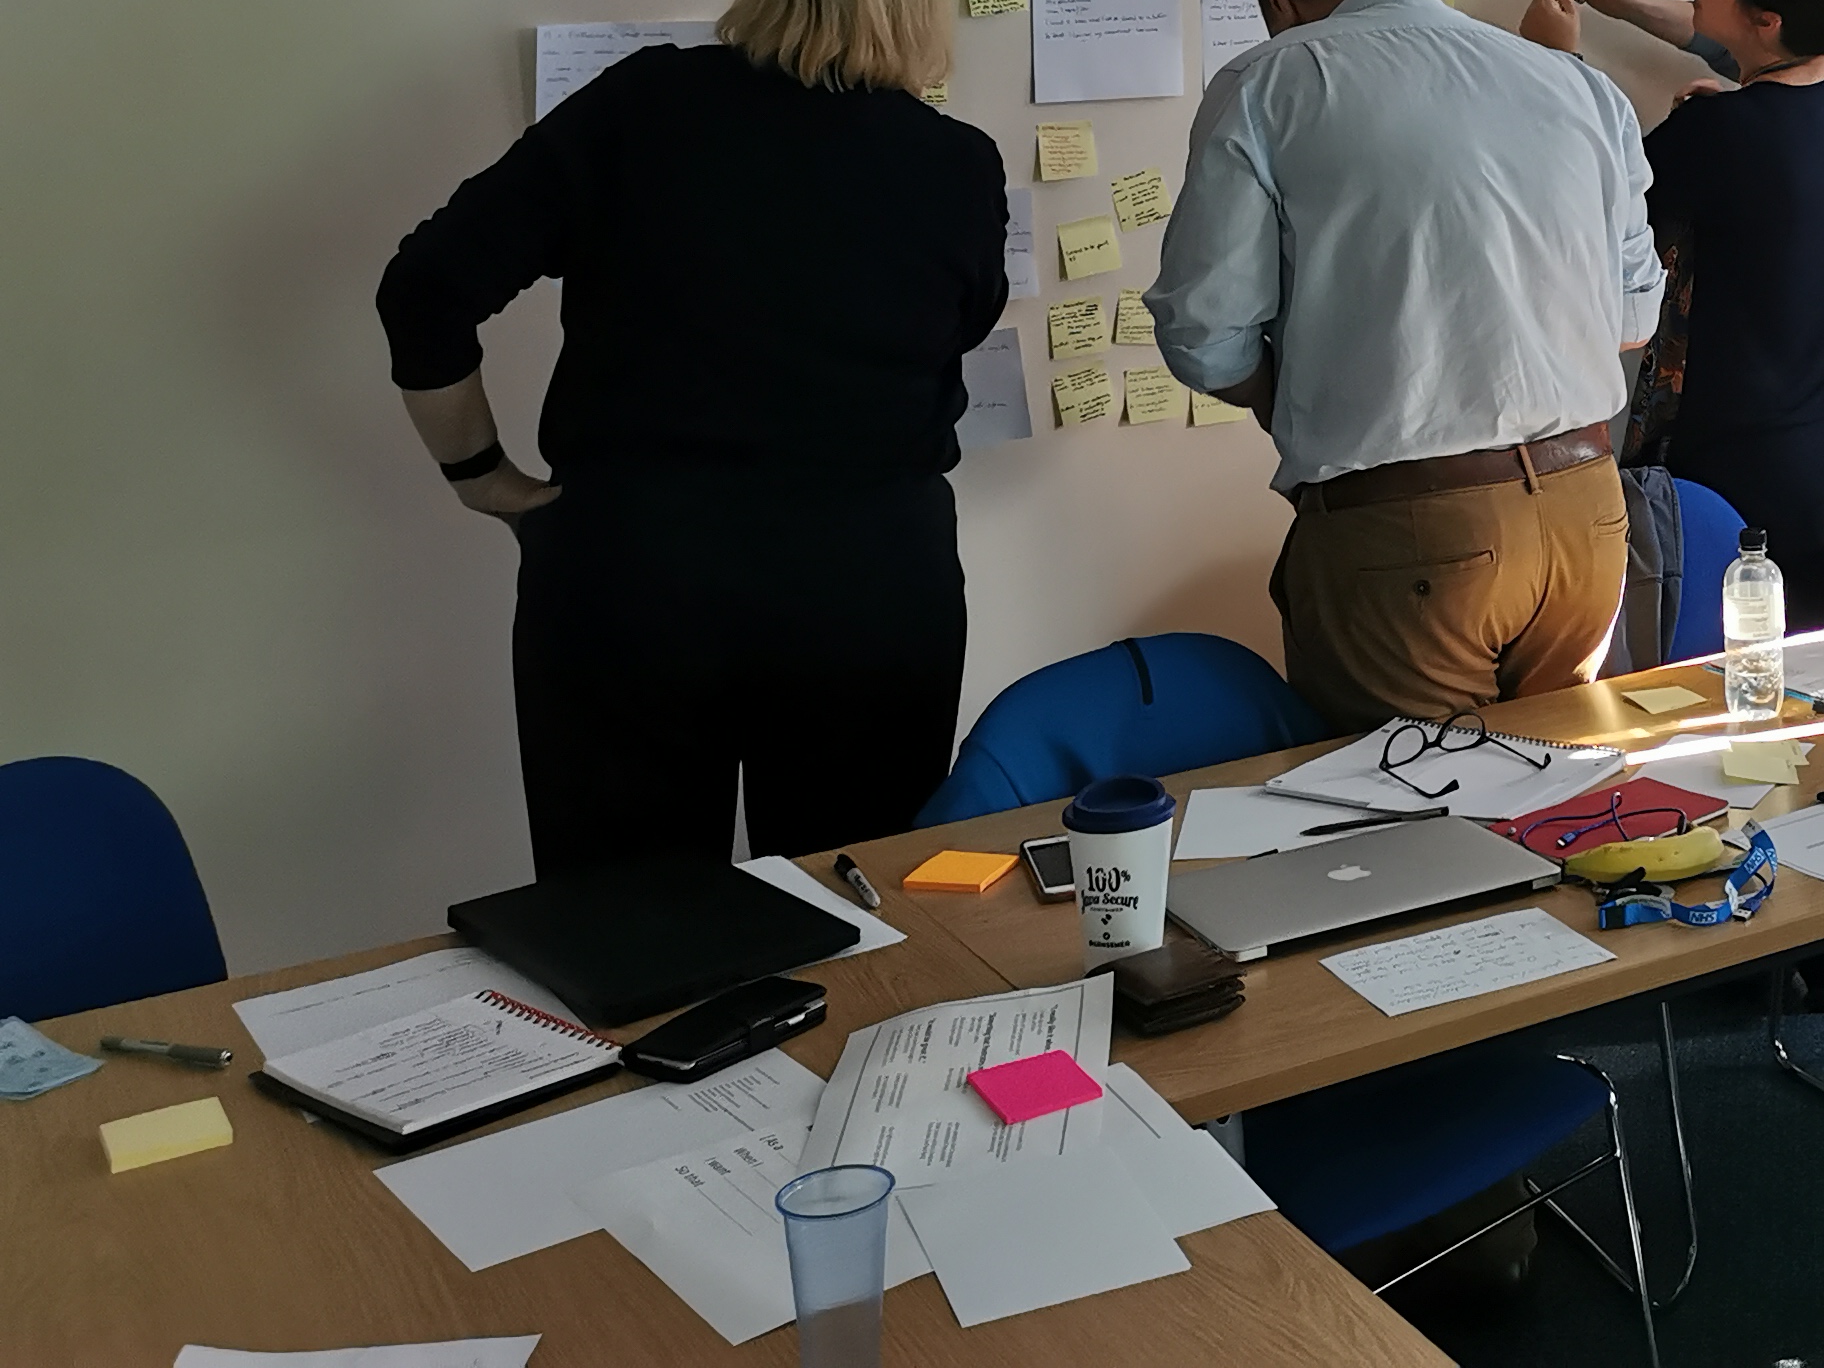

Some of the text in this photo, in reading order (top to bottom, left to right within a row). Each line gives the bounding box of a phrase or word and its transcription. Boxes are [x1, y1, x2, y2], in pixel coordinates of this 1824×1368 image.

[1086, 866, 1131, 893] 100%
[1102, 892, 1139, 910] Secure
[1691, 911, 1717, 924] NHS
[675, 1165, 706, 1188] So that
